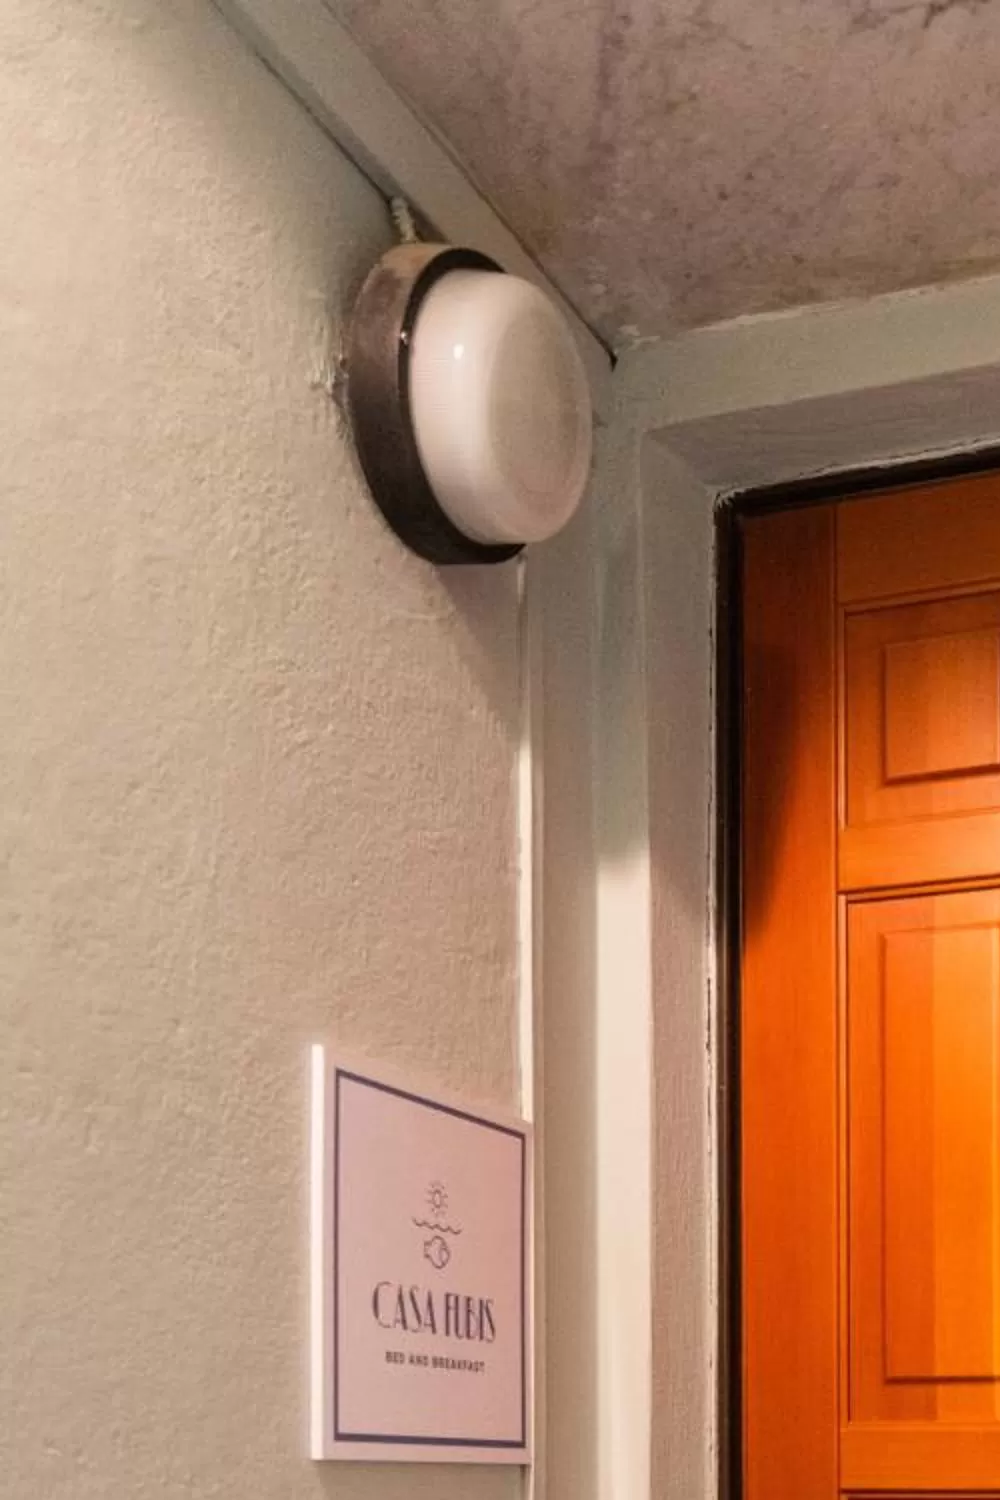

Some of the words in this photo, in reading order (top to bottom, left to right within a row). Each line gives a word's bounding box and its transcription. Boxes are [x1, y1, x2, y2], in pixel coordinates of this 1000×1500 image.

[372, 1280, 437, 1335] CASA
[385, 1351, 405, 1364] BED
[408, 1354, 428, 1367] AND
[431, 1356, 485, 1373] BREAKFAST
